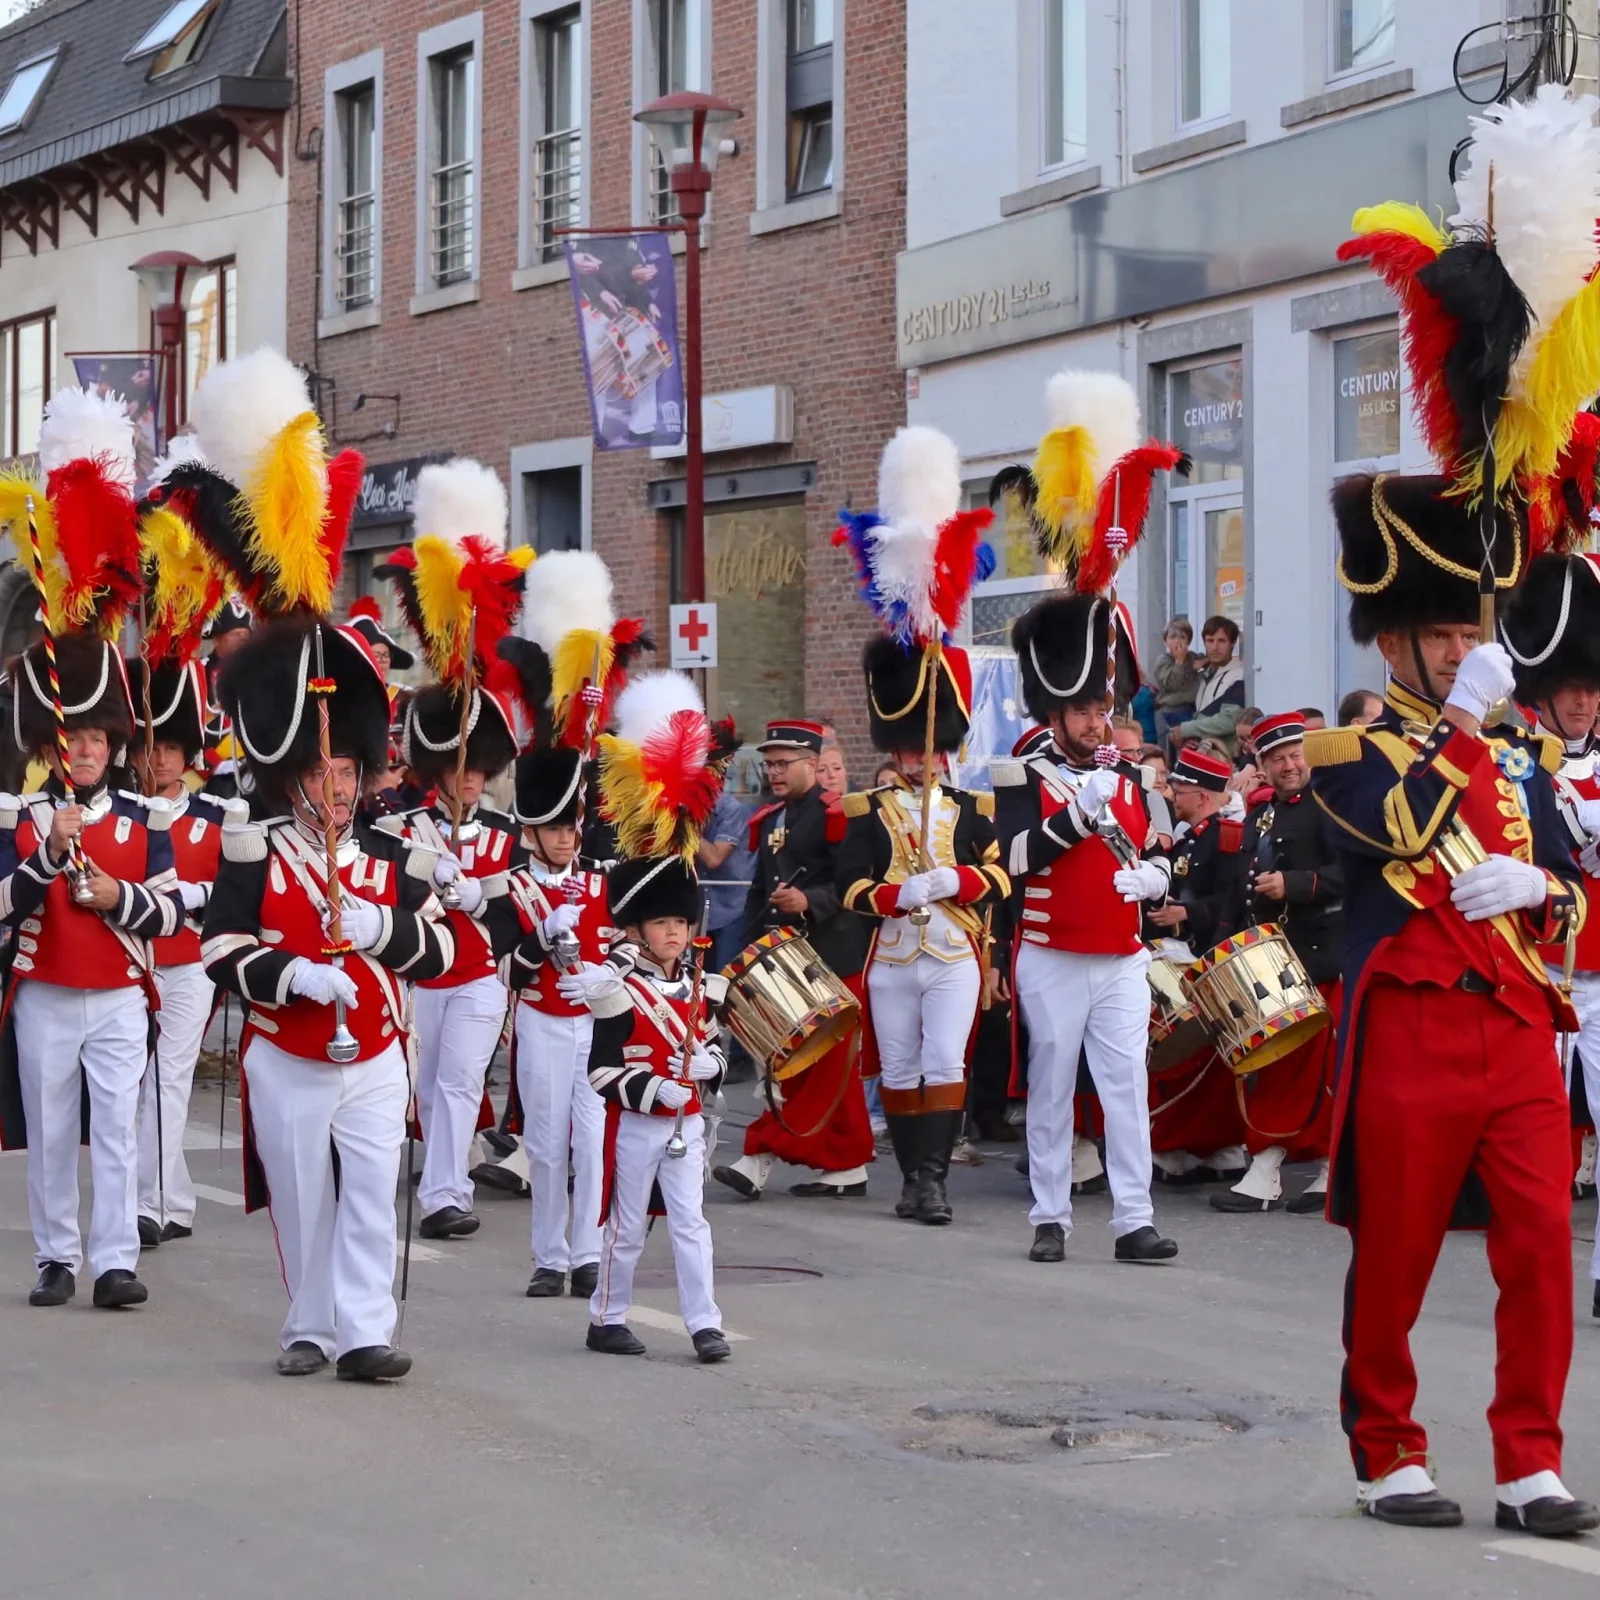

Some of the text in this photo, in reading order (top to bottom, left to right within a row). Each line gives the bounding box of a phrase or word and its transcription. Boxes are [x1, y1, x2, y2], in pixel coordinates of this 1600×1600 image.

[903, 291, 985, 345] CENTURY
[988, 287, 1006, 326] 21
[1340, 369, 1399, 398] CENTURY
[1184, 400, 1244, 428] CENTURY 2
[1358, 399, 1396, 418] LES LACS
